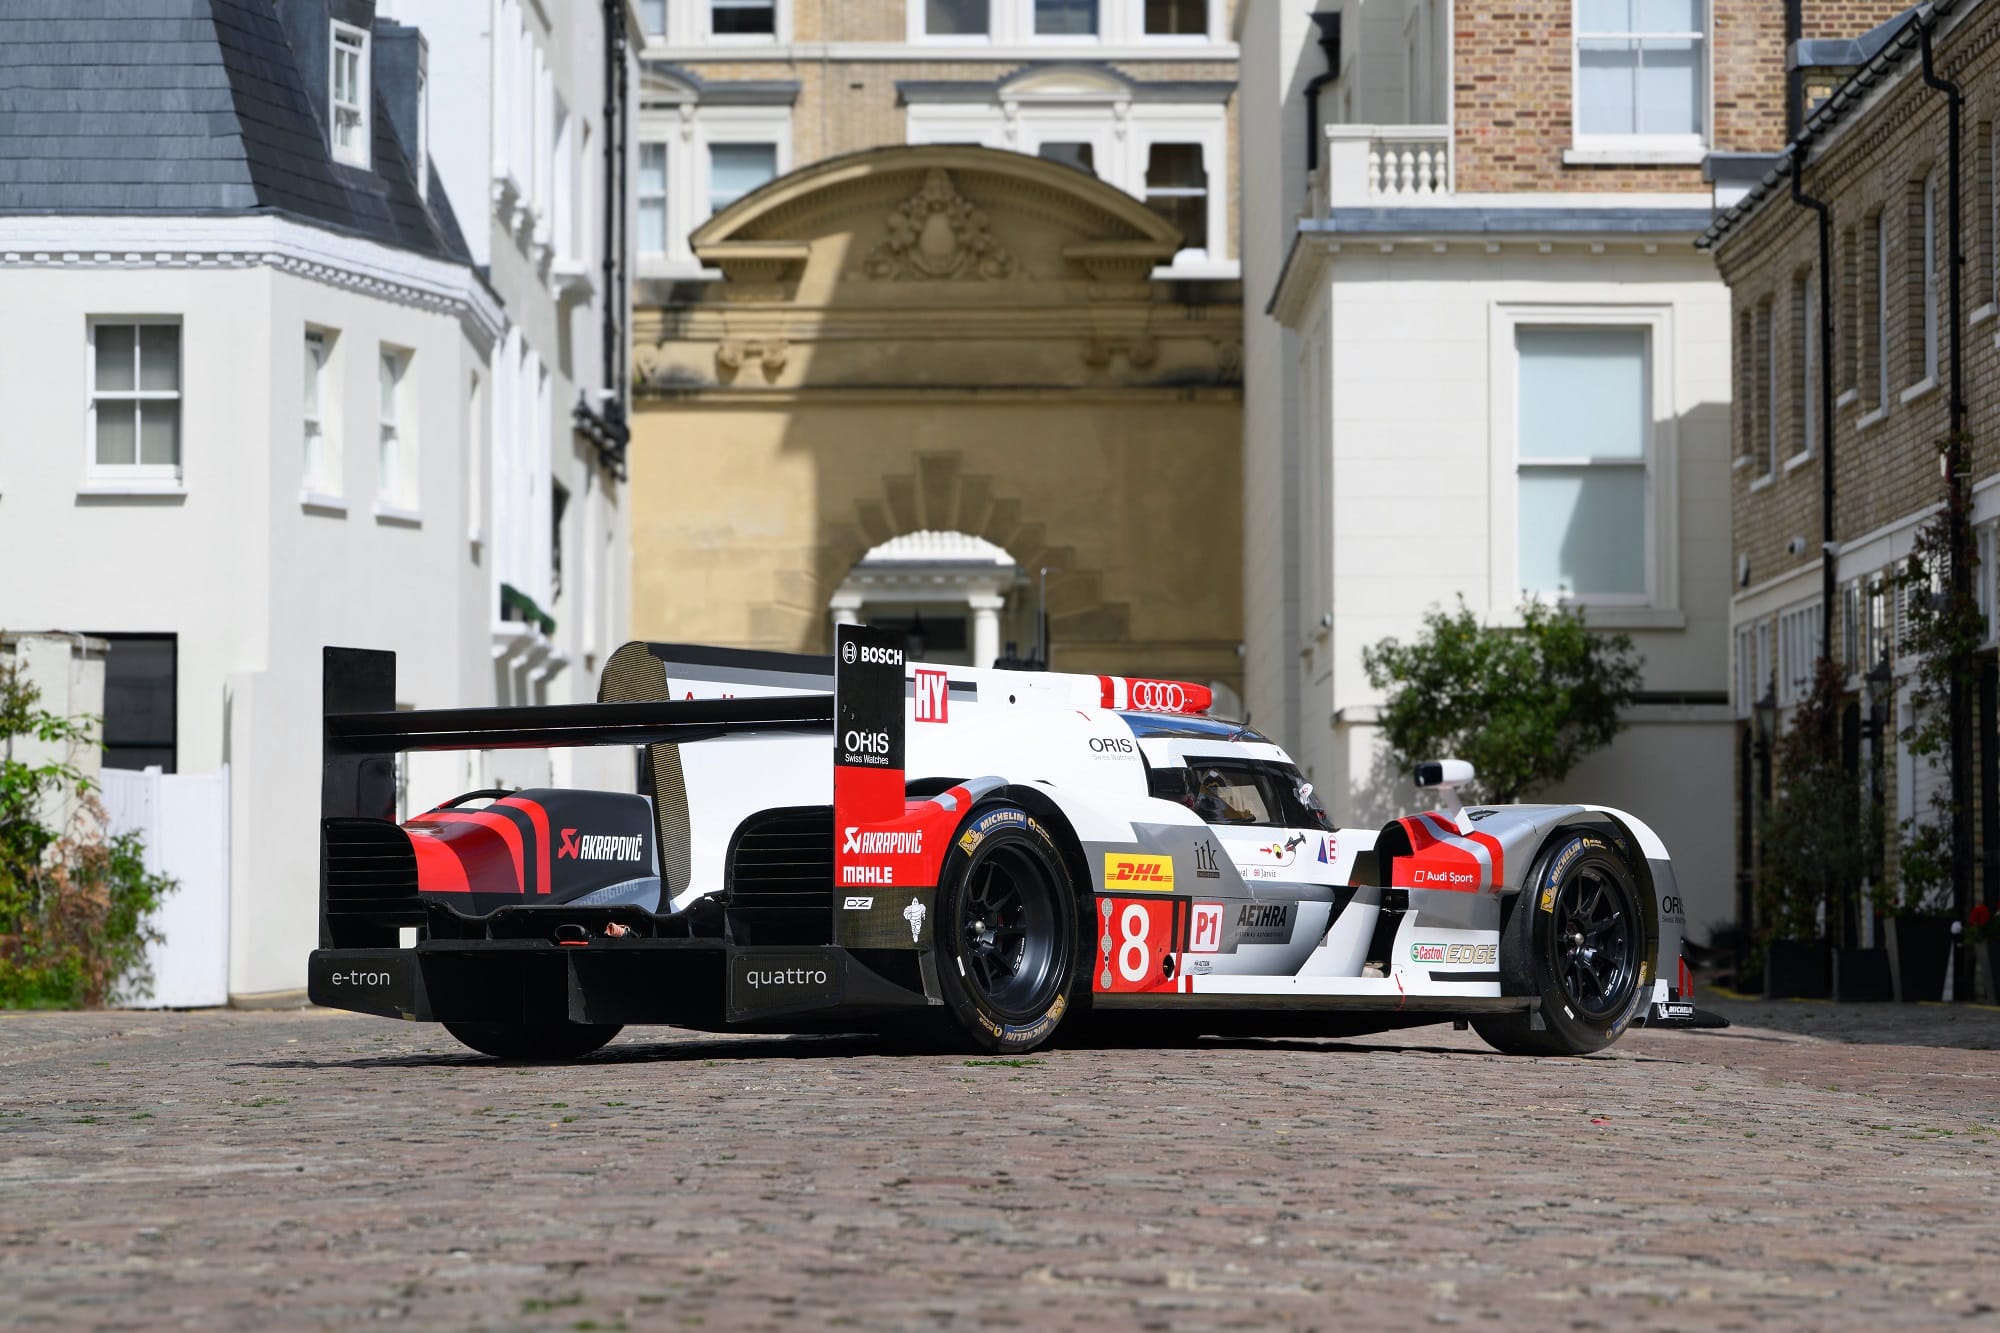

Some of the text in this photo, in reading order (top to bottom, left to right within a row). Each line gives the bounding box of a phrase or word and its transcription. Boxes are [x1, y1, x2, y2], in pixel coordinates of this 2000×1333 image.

[861, 646, 903, 666] BOSCH
[915, 673, 946, 720] HY
[845, 730, 889, 754] ORIS
[1089, 737, 1133, 753] ORIS
[845, 753, 889, 765] Swiss Watches
[980, 811, 1025, 831] MICHELIN
[1194, 839, 1220, 871] itk
[1329, 839, 1337, 860] E
[1116, 862, 1164, 882] DHL
[1551, 842, 1581, 884] MICHELIN
[843, 866, 893, 884] MAHLE
[1260, 868, 1277, 879] Jarvis
[1427, 871, 1474, 884] Audi Sport
[846, 899, 870, 908] OZ
[1662, 895, 1685, 914] ORI
[1236, 904, 1288, 927] AETHRA
[1195, 911, 1218, 945] P1
[1118, 903, 1150, 982] 8
[1419, 943, 1497, 965] Castrol EDGE
[331, 969, 391, 986] e-tron
[746, 968, 827, 989] quattro
[1668, 1005, 1693, 1014] MICHELIN
[1004, 1020, 1049, 1041] MICHELIN
